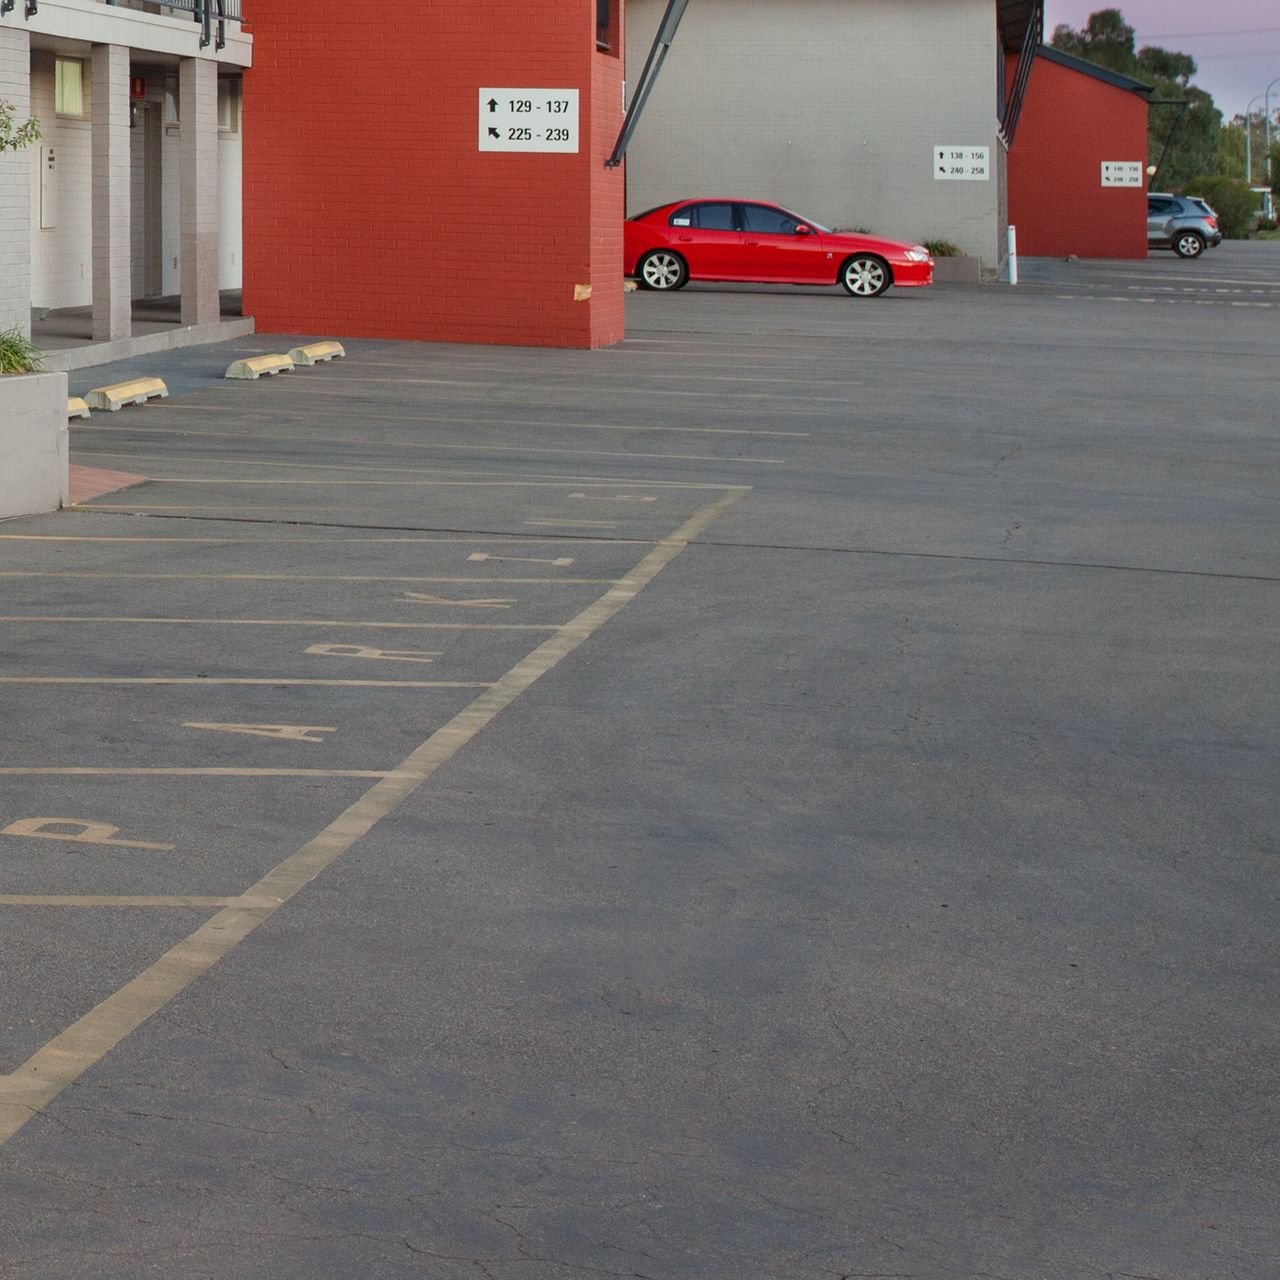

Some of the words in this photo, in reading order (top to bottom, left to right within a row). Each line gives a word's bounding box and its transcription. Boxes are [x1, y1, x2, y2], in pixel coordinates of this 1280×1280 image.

[508, 100, 532, 113] 129
[546, 100, 569, 113] 137
[508, 128, 532, 141] 225
[545, 128, 570, 141] 239
[950, 152, 964, 160] 138
[971, 152, 985, 160] 156
[950, 167, 964, 175] 240
